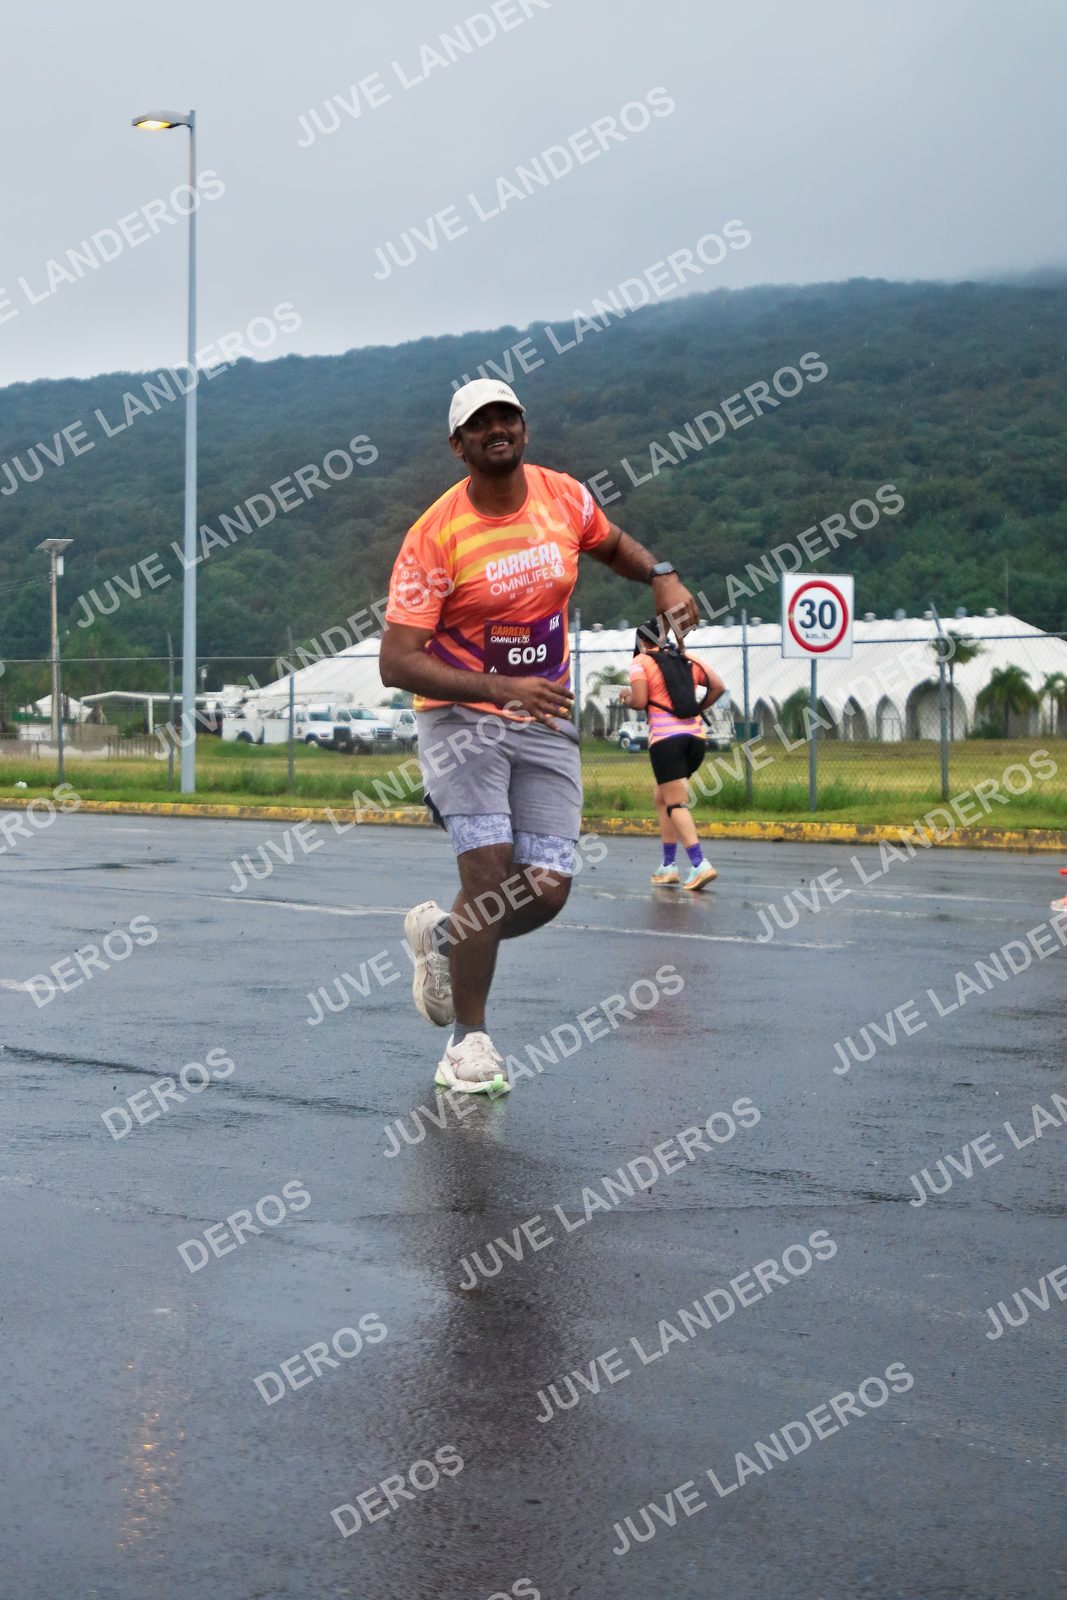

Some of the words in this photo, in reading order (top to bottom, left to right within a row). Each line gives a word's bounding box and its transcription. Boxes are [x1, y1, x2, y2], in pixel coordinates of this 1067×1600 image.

[486, 542, 562, 582] CARRERA
[490, 567, 550, 595] OMNILIFE
[549, 614, 560, 631] 15K
[799, 598, 837, 630] 30
[490, 625, 531, 636] CARRERA
[508, 643, 547, 665] 609
